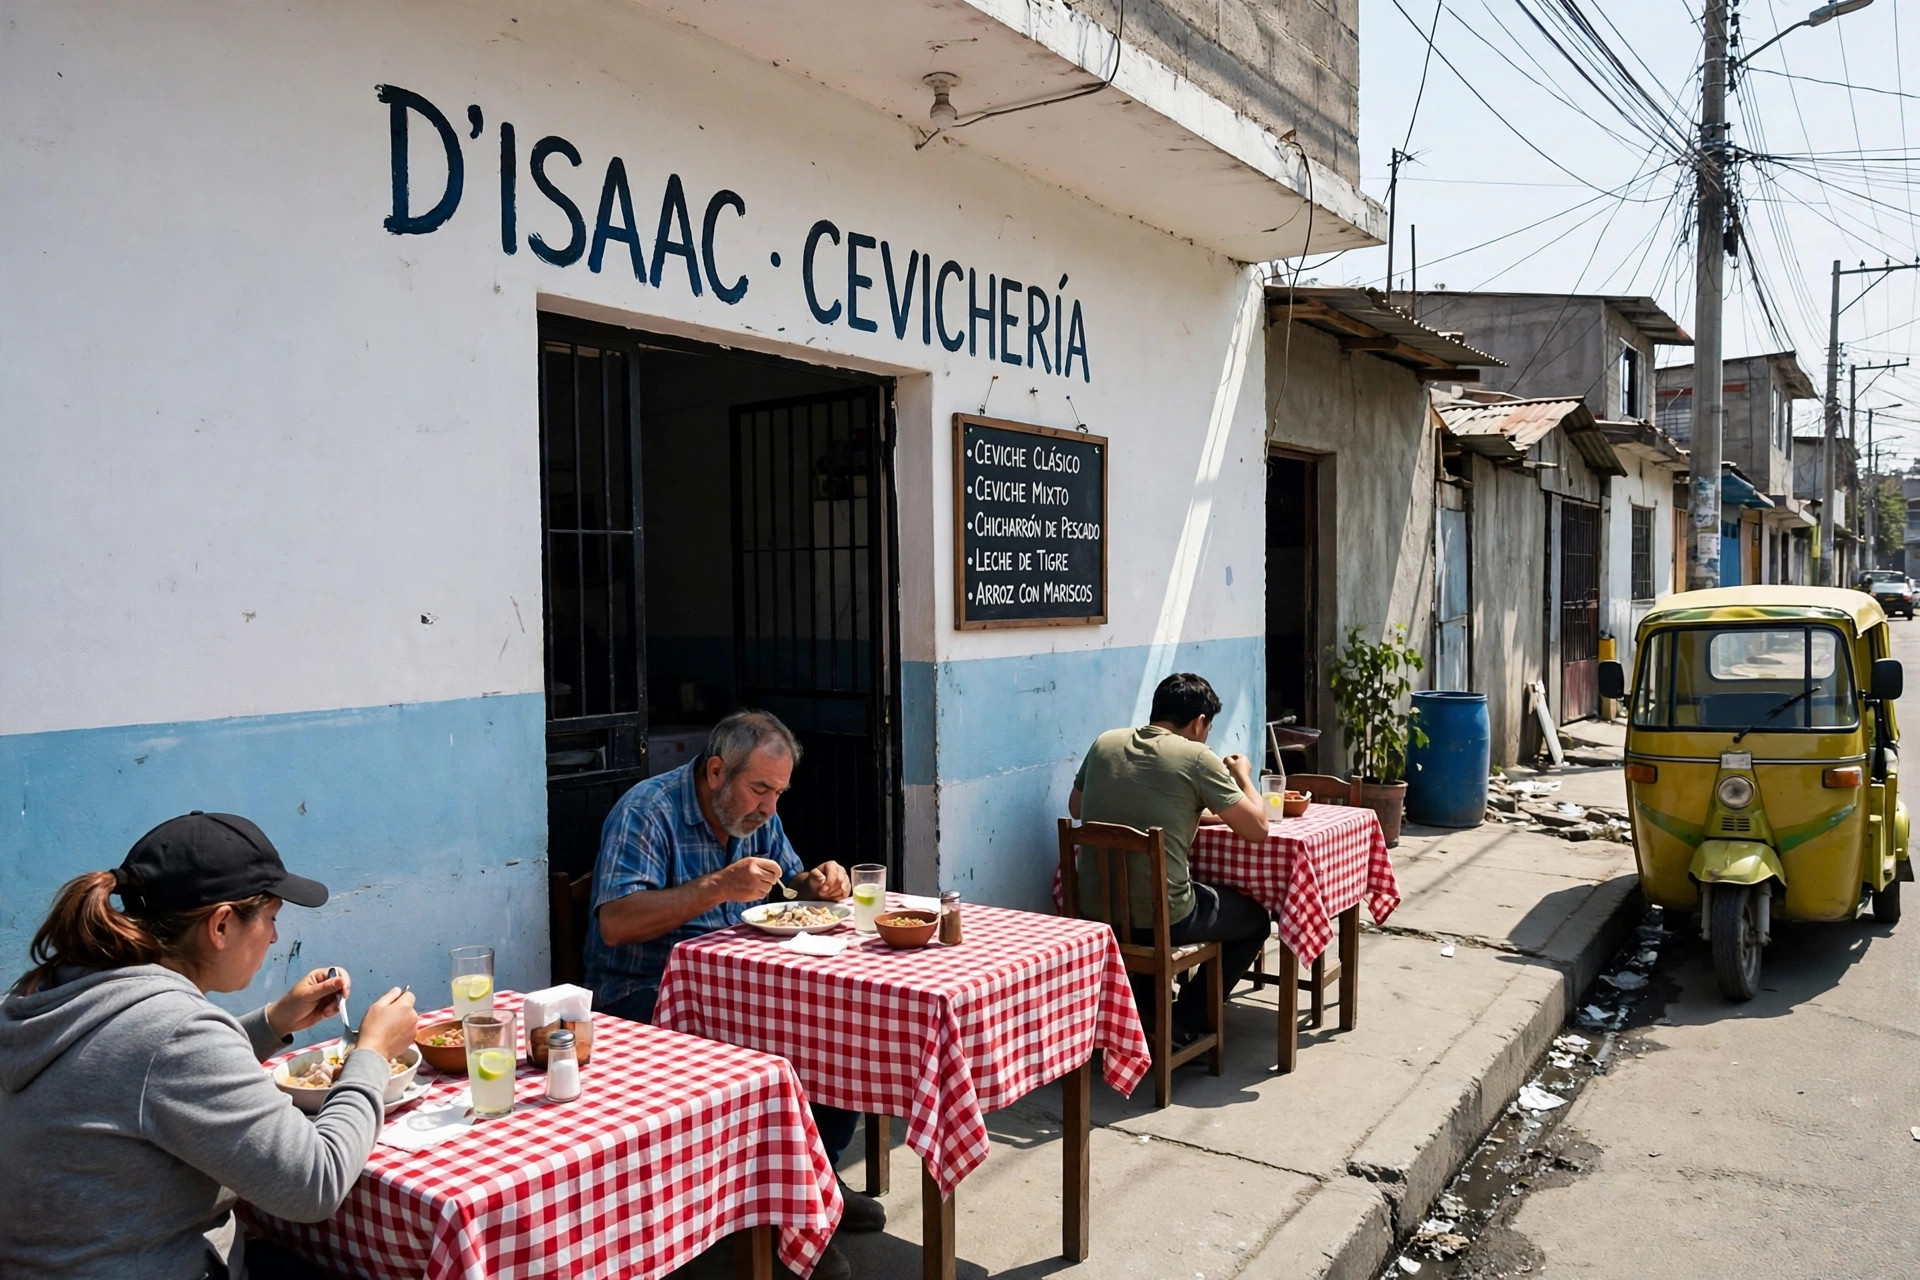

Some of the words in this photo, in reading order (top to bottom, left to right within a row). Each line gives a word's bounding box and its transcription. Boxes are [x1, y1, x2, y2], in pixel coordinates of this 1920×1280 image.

[375, 84, 749, 305] D'ISAAC
[803, 220, 1089, 383] CEVICHERÍA
[975, 440, 1026, 467] CEVICHE
[1034, 446, 1080, 473] CLÁSICO
[975, 476, 1026, 502] CEVICHE
[1033, 482, 1068, 505] MIXTO
[975, 512, 1041, 537] CHICHARRÓN
[1046, 521, 1057, 538] DE
[1062, 517, 1099, 540] PESCADO
[976, 548, 1012, 571] LECHE
[1019, 553, 1032, 570] DE
[1037, 550, 1068, 571] TIGRE
[976, 582, 1014, 605] ARROZ
[1019, 584, 1039, 603] CON
[1044, 582, 1092, 603] MARISCOS
